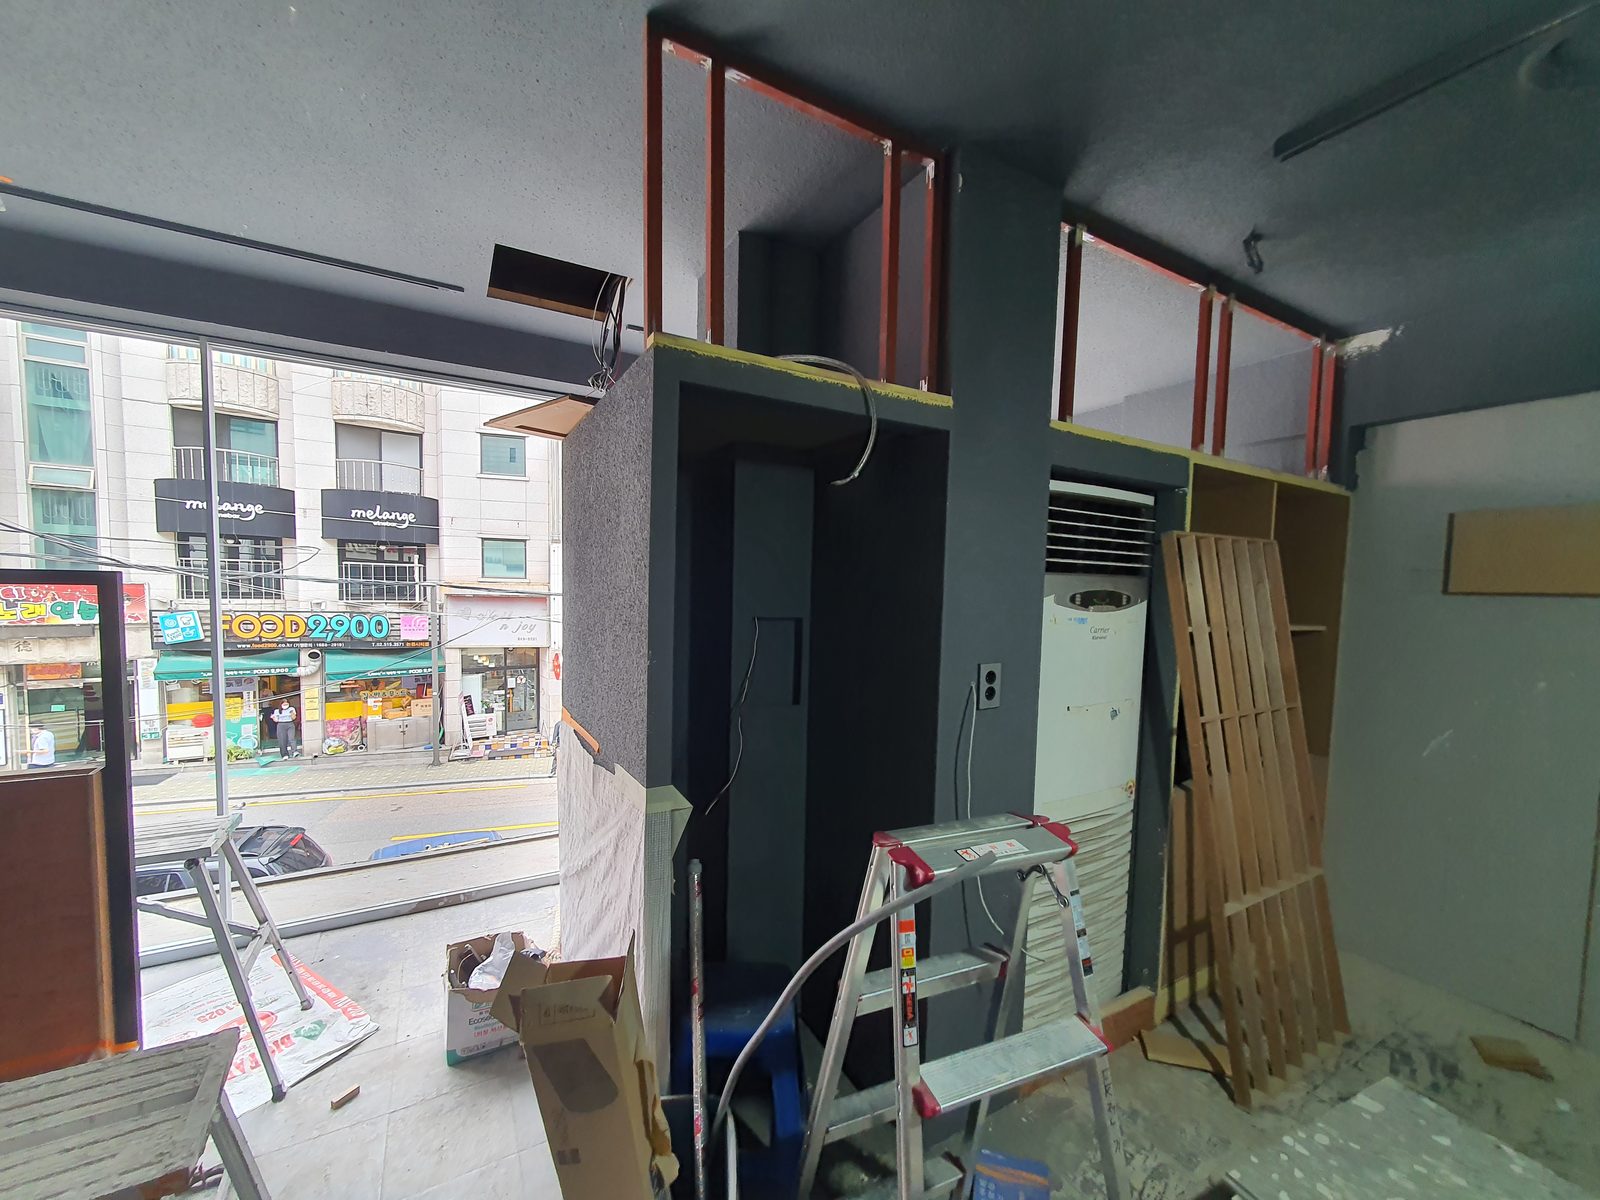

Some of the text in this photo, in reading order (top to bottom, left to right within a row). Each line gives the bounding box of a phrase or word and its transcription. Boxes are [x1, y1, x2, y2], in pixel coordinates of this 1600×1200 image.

[185, 496, 265, 521] mlange
[351, 505, 417, 528] melange
[221, 614, 390, 641] FOOD 2,900
[511, 621, 537, 634] joy
